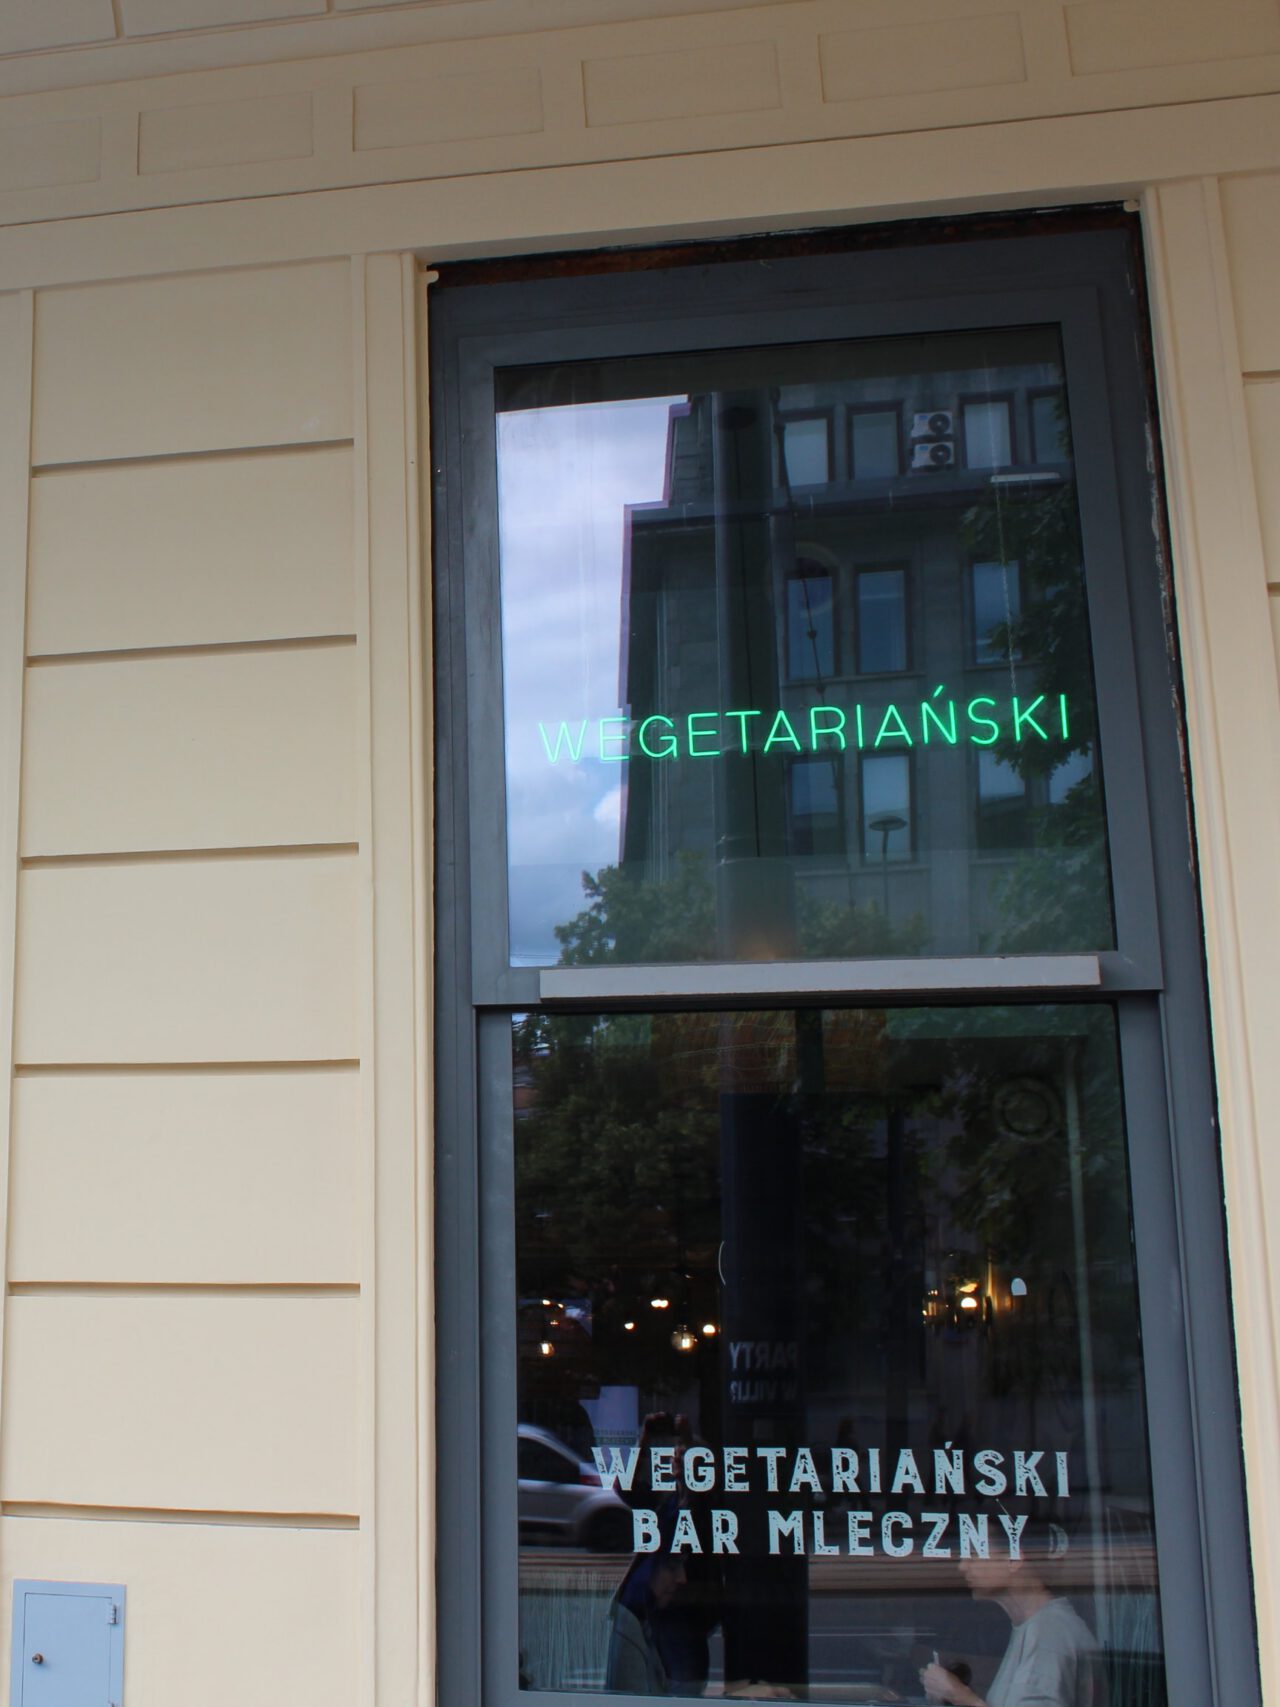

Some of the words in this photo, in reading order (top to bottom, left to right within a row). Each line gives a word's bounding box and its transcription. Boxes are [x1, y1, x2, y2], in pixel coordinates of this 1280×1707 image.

[538, 685, 1068, 764] WEGETARIAŃSKI
[591, 1441, 1070, 1497] WEGETARIAŃSKI
[632, 1508, 740, 1555] BAR
[768, 1510, 1029, 1561] MLECZNY
